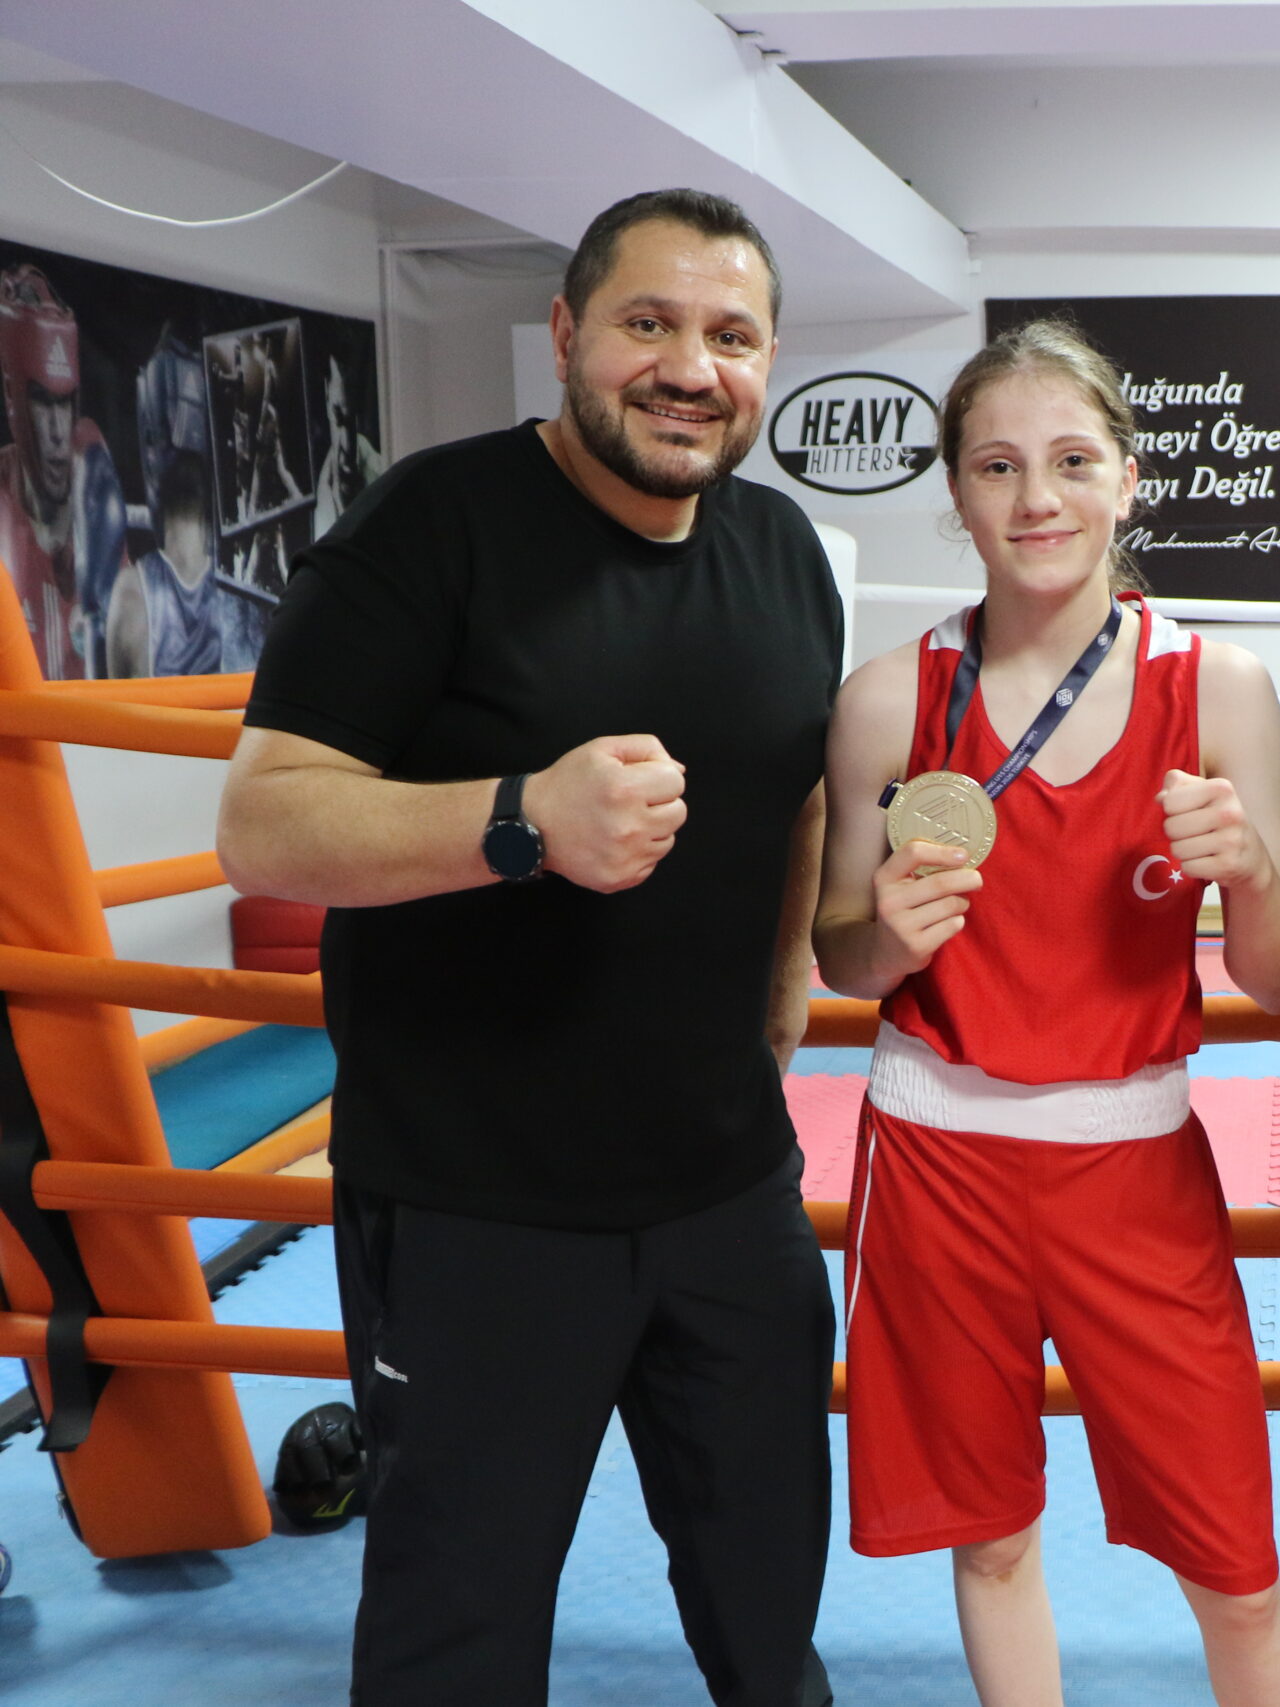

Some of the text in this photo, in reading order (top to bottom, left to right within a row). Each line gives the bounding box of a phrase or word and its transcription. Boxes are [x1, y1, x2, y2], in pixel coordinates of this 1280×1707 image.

[800, 397, 914, 447] HEAVY
[810, 446, 893, 474] HITTERS
[1187, 466, 1276, 506] Değil.
[1003, 729, 1038, 772] CHAMPIONSHIPS
